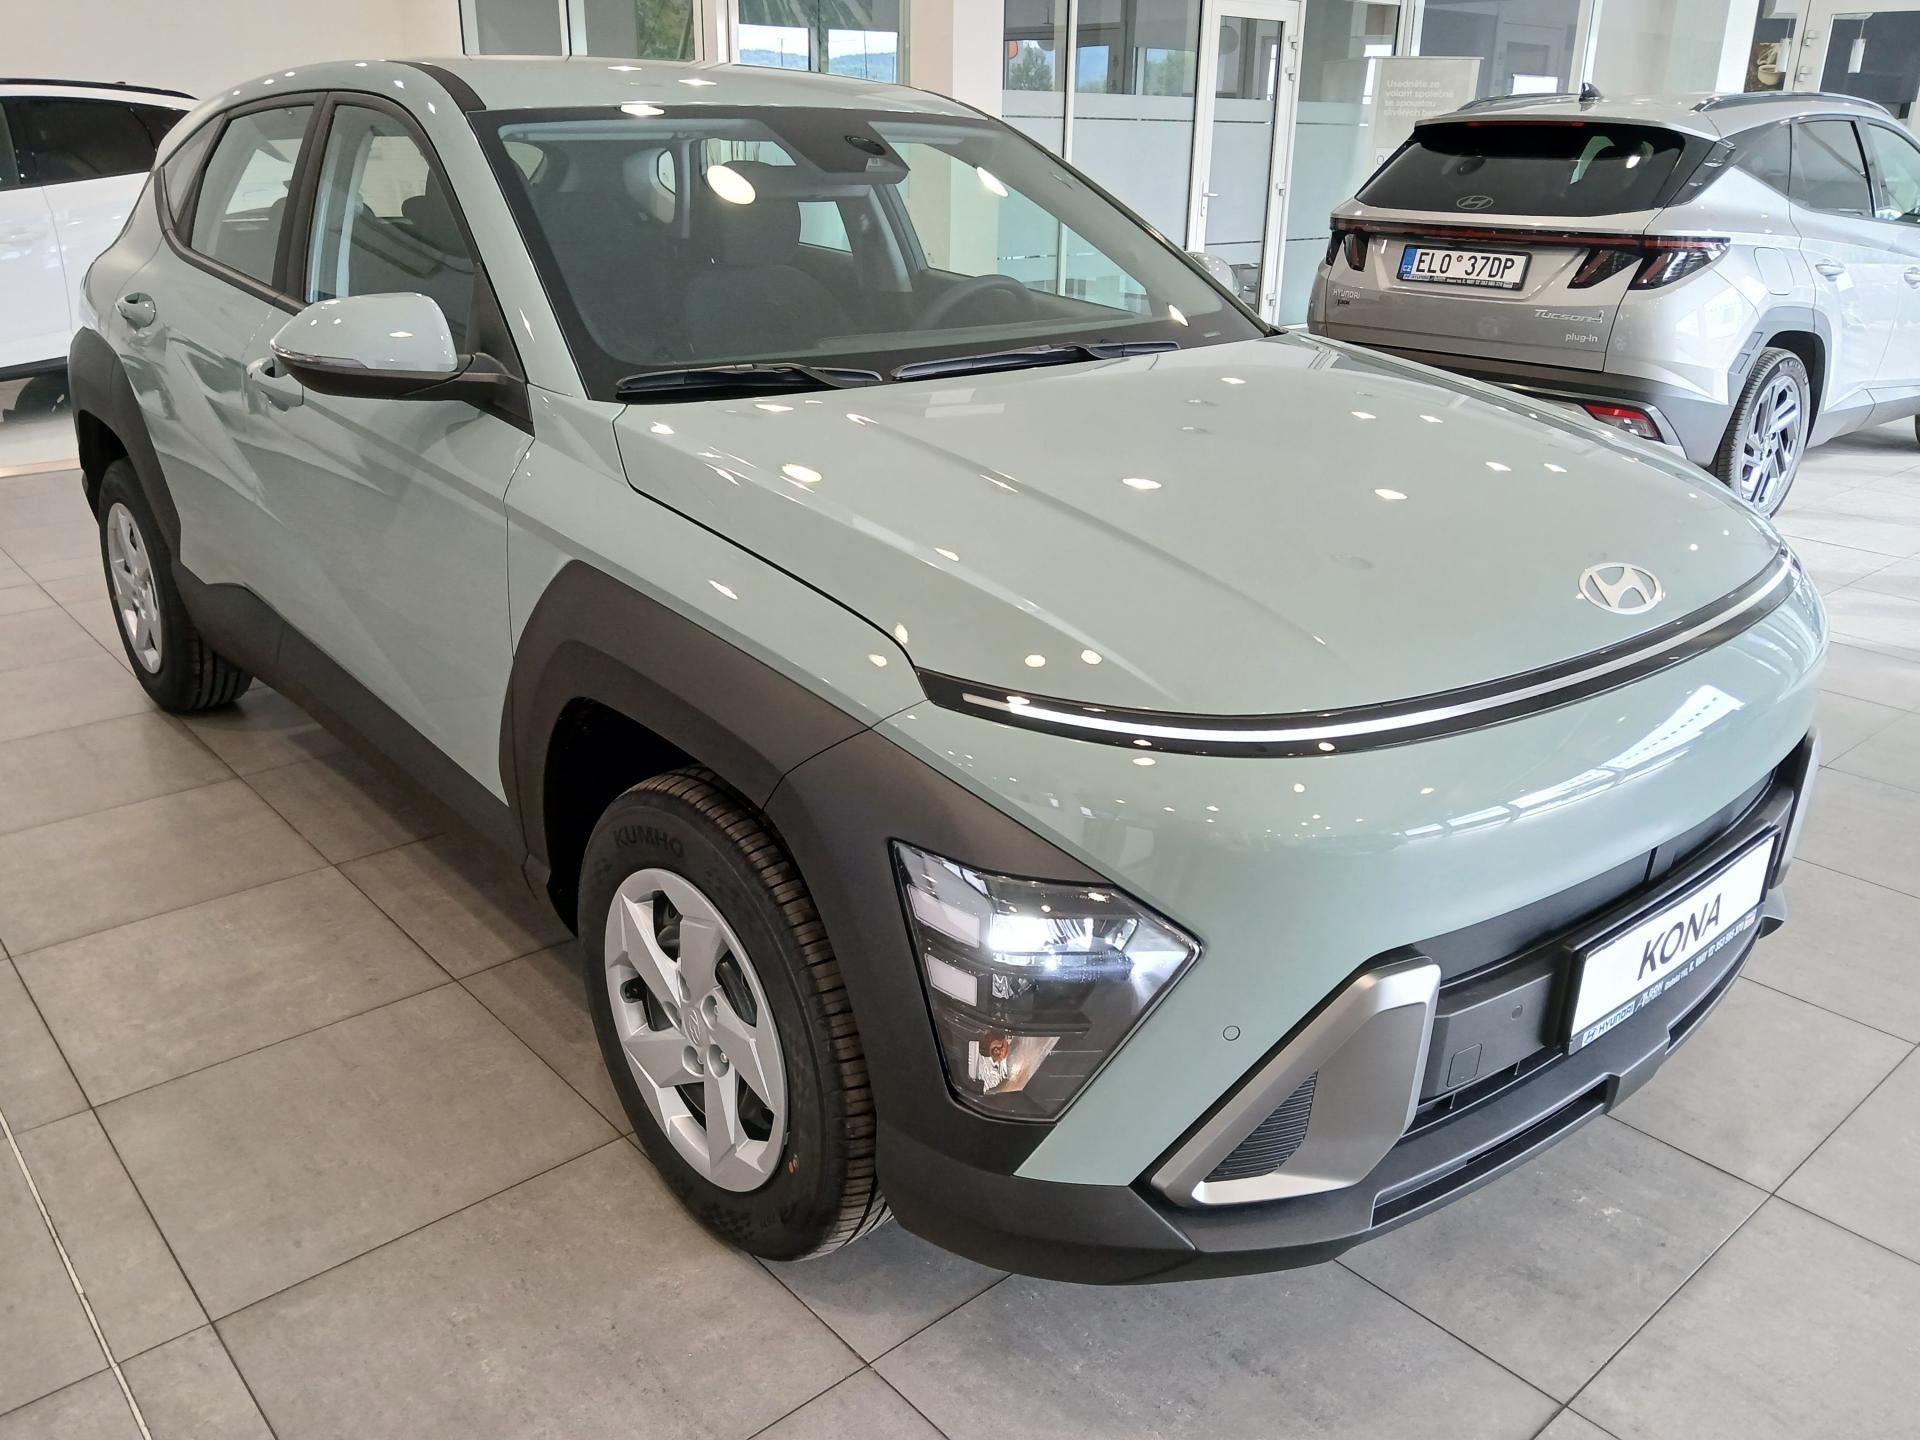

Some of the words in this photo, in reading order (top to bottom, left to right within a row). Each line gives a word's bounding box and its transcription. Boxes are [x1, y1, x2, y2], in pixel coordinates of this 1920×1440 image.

[1402, 264, 1412, 273] CZ
[1464, 255, 1515, 279] 37DP
[1565, 332, 1598, 343] plug-in
[613, 825, 684, 858] KUMHO
[1637, 892, 1722, 982] KONA
